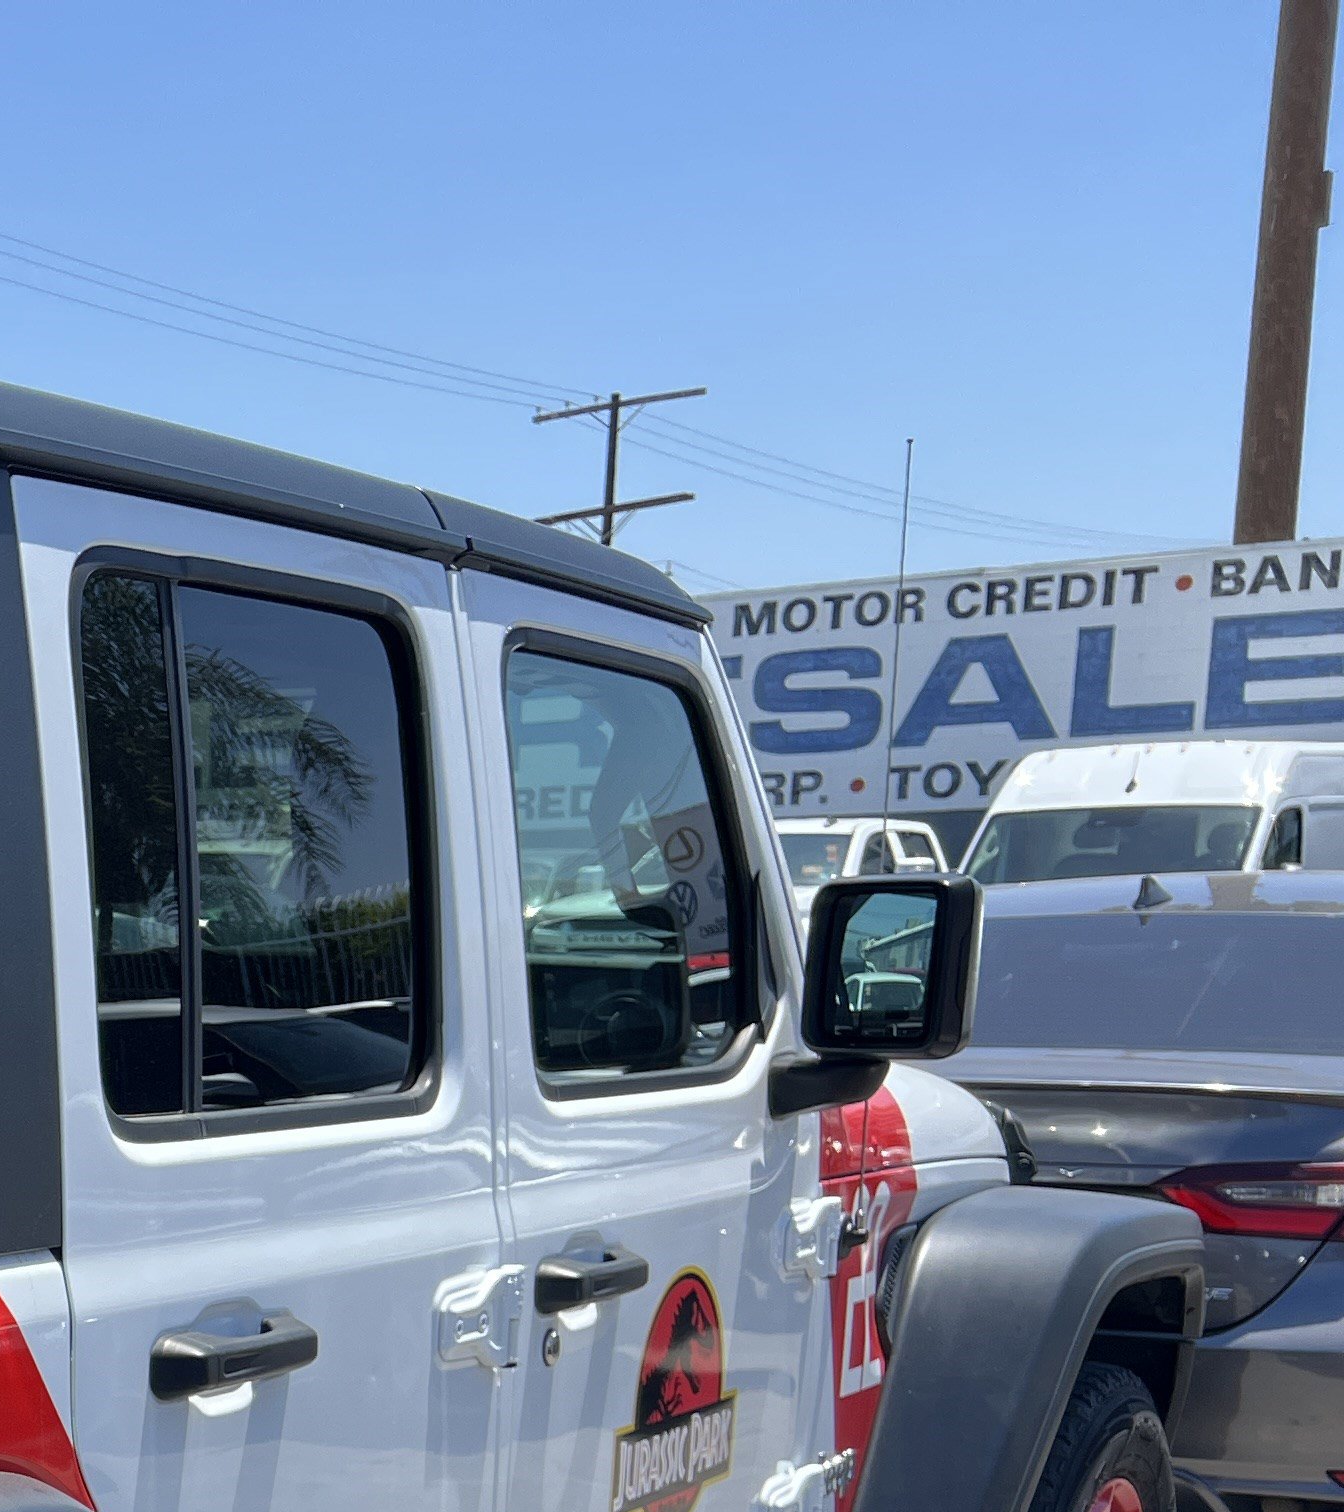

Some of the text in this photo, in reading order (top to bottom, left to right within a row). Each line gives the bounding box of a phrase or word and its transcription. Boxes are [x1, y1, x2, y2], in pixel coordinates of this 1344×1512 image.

[732, 549, 1341, 638] MOTOR CREDIT BAN
[726, 609, 1344, 754] SALE
[889, 758, 1009, 800] TOY
[613, 1407, 732, 1512] JURASSIC PARK
